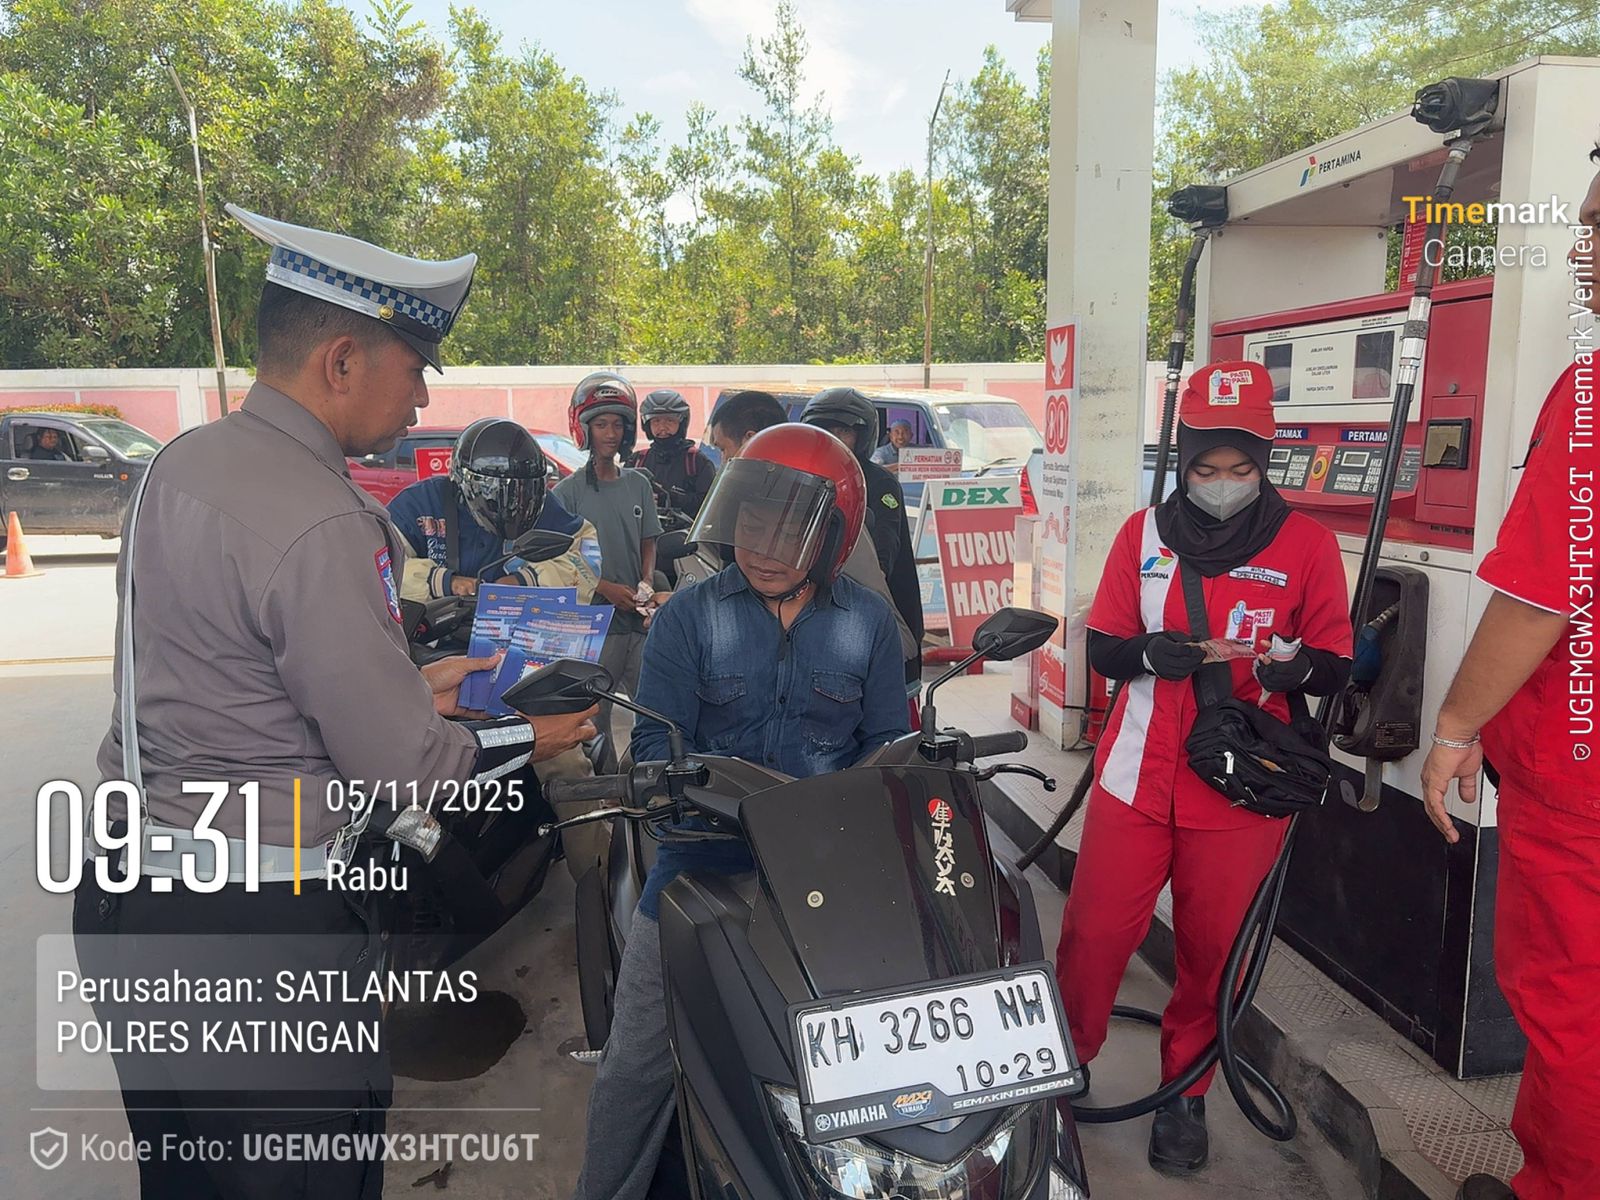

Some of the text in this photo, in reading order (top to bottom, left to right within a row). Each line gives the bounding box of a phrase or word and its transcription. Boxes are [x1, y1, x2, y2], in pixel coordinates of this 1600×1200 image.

[1319, 150, 1361, 174] PERTAMINA
[1045, 395, 1069, 454] 80
[1275, 429, 1302, 439] RTAMAX
[1348, 431, 1388, 442] PERTAMA
[942, 487, 1010, 506] DEX
[951, 578, 1013, 616] HARG
[806, 981, 1046, 1068] KH 3266 NW
[953, 1077, 1075, 1110] SEMAKIN DI DEPAN
[831, 1103, 888, 1128] YAMAHA
[901, 1103, 924, 1114] YAMAHA
